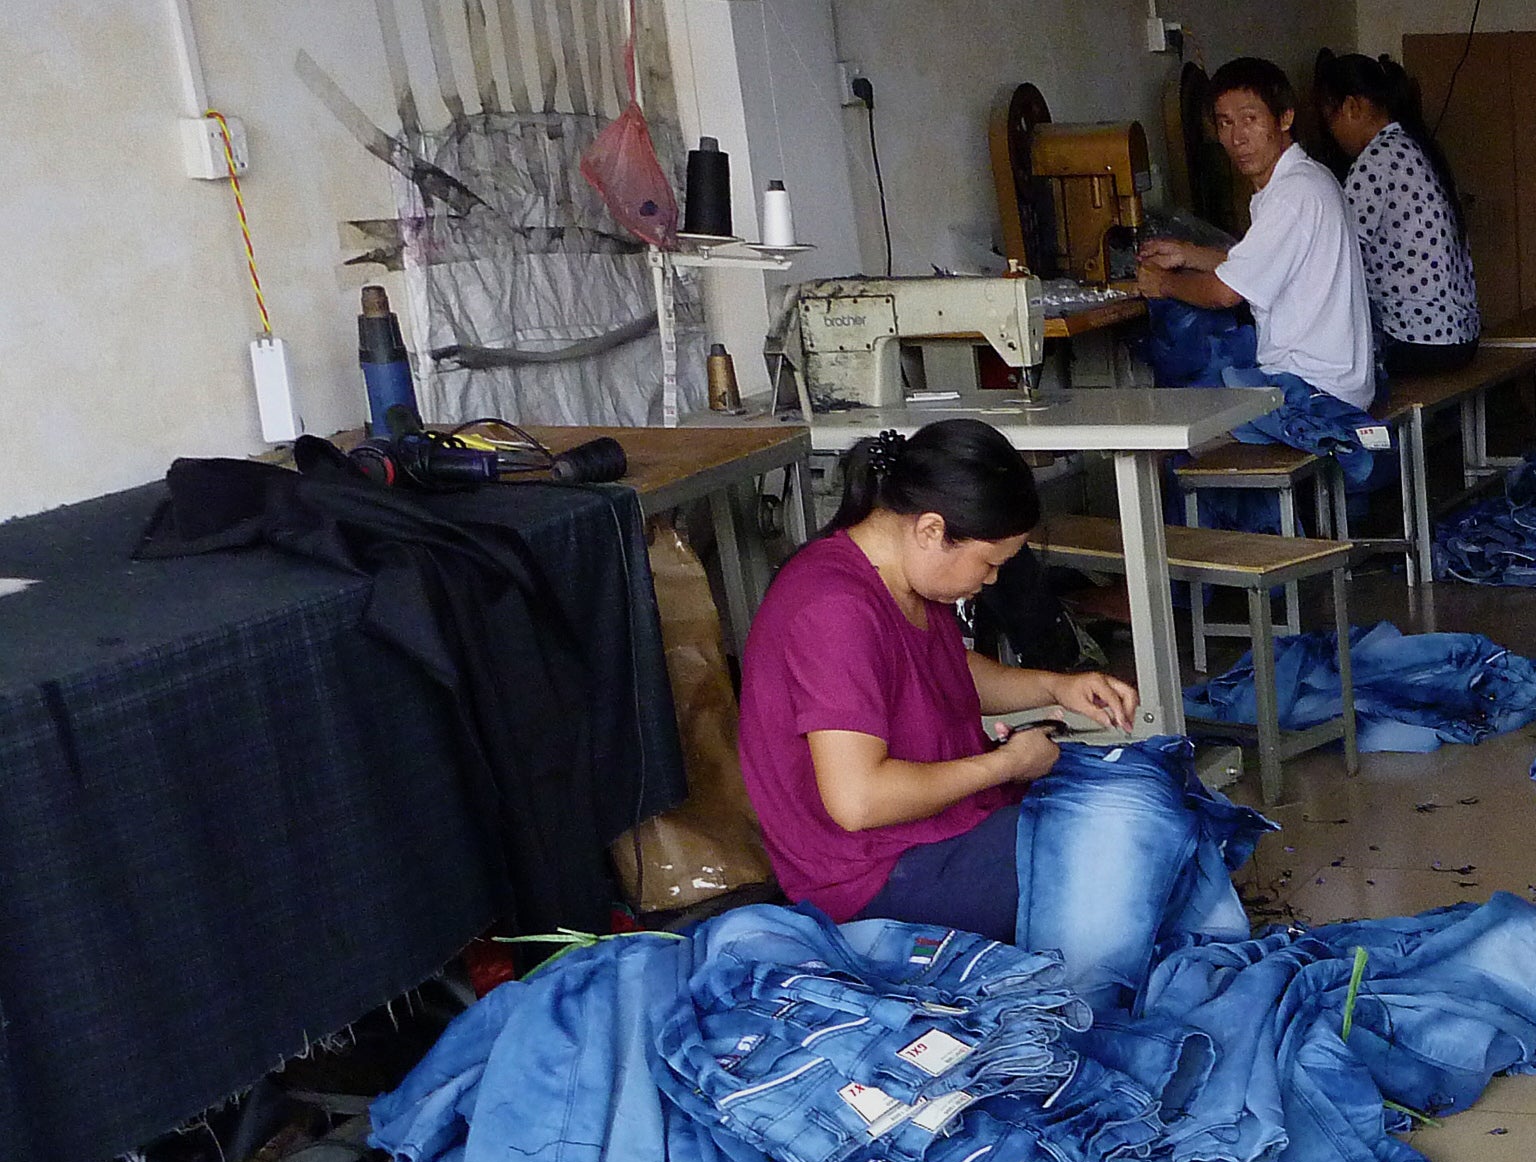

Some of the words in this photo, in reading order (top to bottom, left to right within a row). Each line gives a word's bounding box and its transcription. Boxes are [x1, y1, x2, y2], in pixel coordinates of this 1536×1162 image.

[823, 315, 867, 328] brother
[906, 1043, 928, 1058] GXL
[849, 1084, 866, 1097] XL
